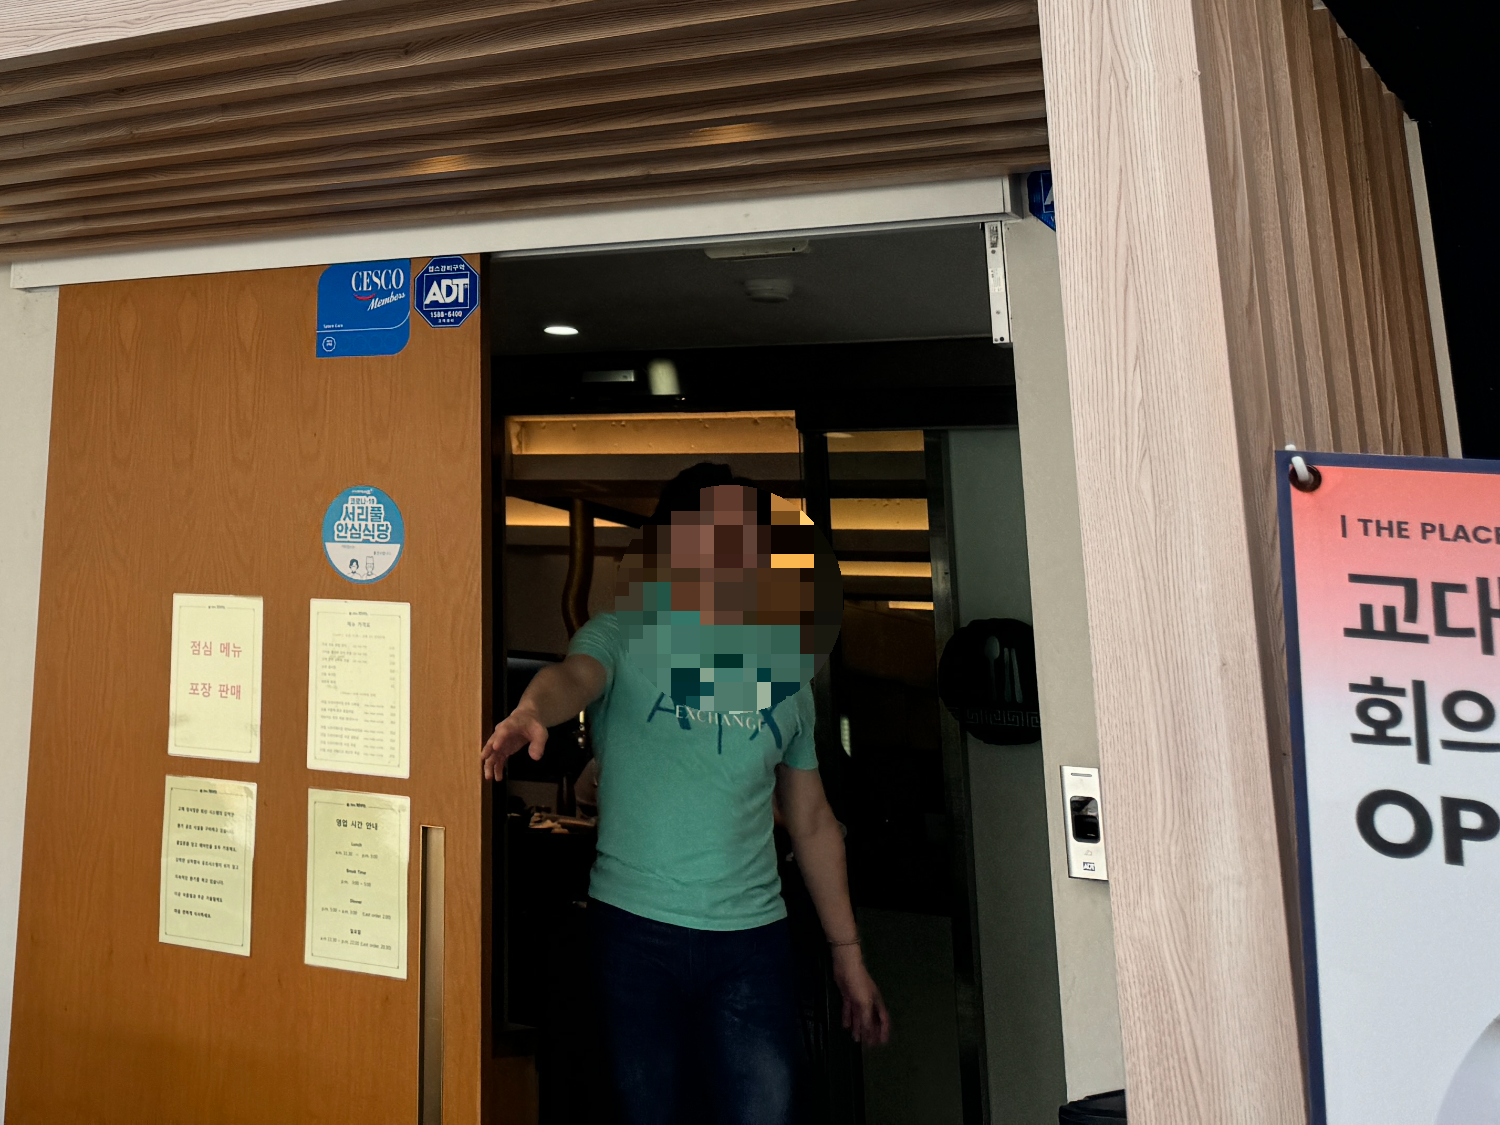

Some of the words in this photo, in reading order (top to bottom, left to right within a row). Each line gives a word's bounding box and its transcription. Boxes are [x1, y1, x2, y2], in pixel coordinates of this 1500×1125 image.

[351, 268, 404, 292] CESCO
[424, 277, 470, 305] ADT
[342, 505, 383, 523] 서리풀
[336, 522, 390, 540] 안심식당
[1357, 517, 1411, 539] THE
[190, 640, 213, 657] 점심
[219, 642, 242, 658] 메뉴
[188, 682, 212, 698] 포장
[218, 683, 242, 700] 판매
[336, 818, 348, 827] 영업
[350, 820, 363, 829] 시간
[365, 821, 378, 831] 안내
[1355, 788, 1500, 867] OP
